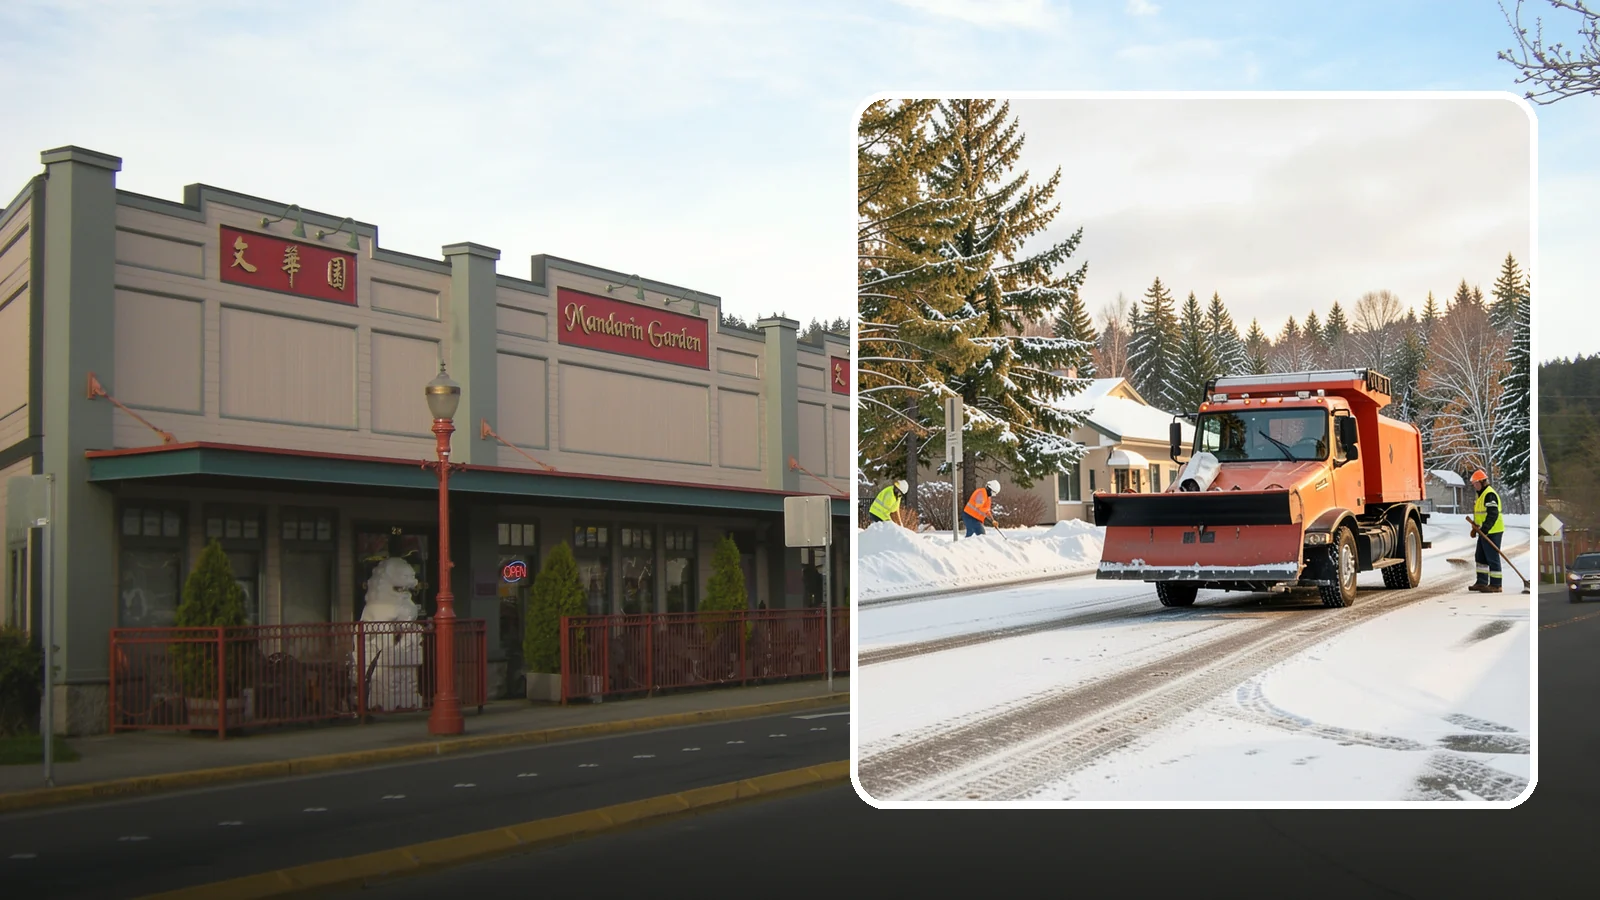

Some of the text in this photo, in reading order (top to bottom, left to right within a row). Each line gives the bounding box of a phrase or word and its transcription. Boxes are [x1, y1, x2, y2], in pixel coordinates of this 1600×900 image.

[230, 235, 347, 291] 文華園
[564, 302, 702, 352] Mandarin Garden
[503, 565, 527, 578] OPEN
